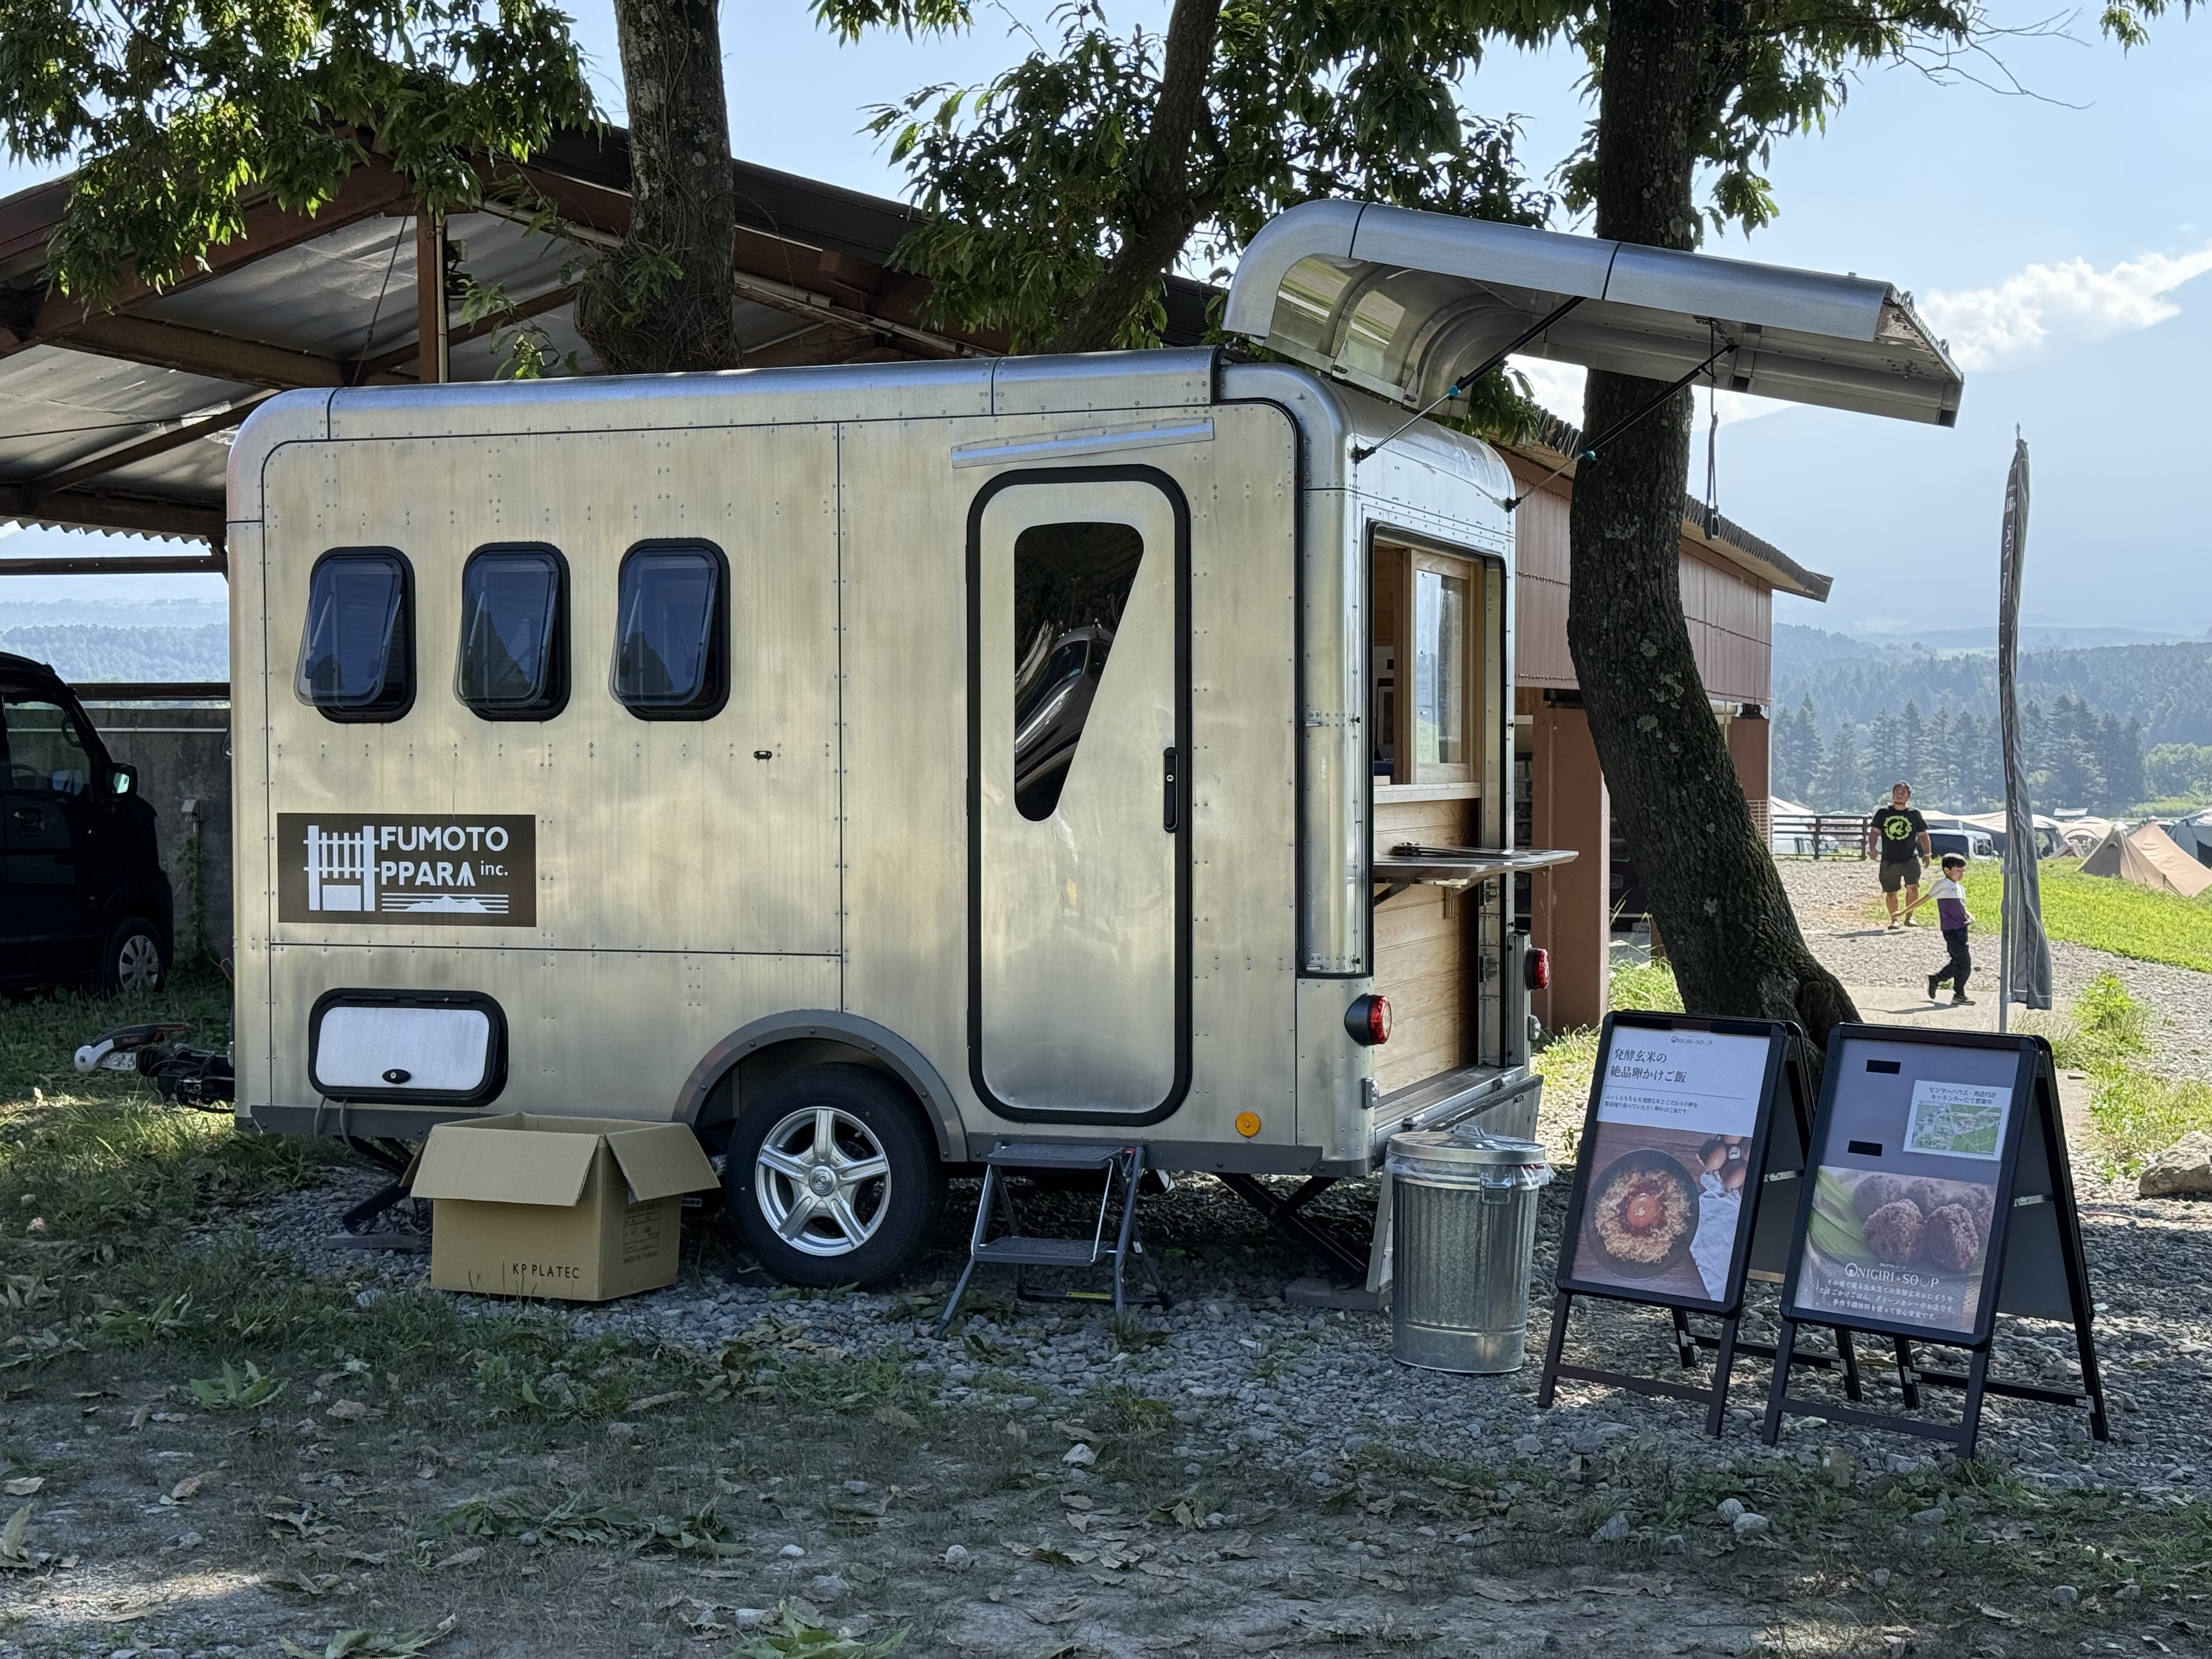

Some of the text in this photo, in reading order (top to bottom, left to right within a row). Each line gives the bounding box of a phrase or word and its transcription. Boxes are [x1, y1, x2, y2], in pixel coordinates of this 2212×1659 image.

[380, 826, 510, 851] FUMOTO
[380, 860, 509, 887] PPARA inc.
[1612, 1048, 1667, 1064] 発酵玄米の
[1610, 1064, 1688, 1084] 絶品卵かけご飯
[512, 1262, 580, 1279] KP PLATEC
